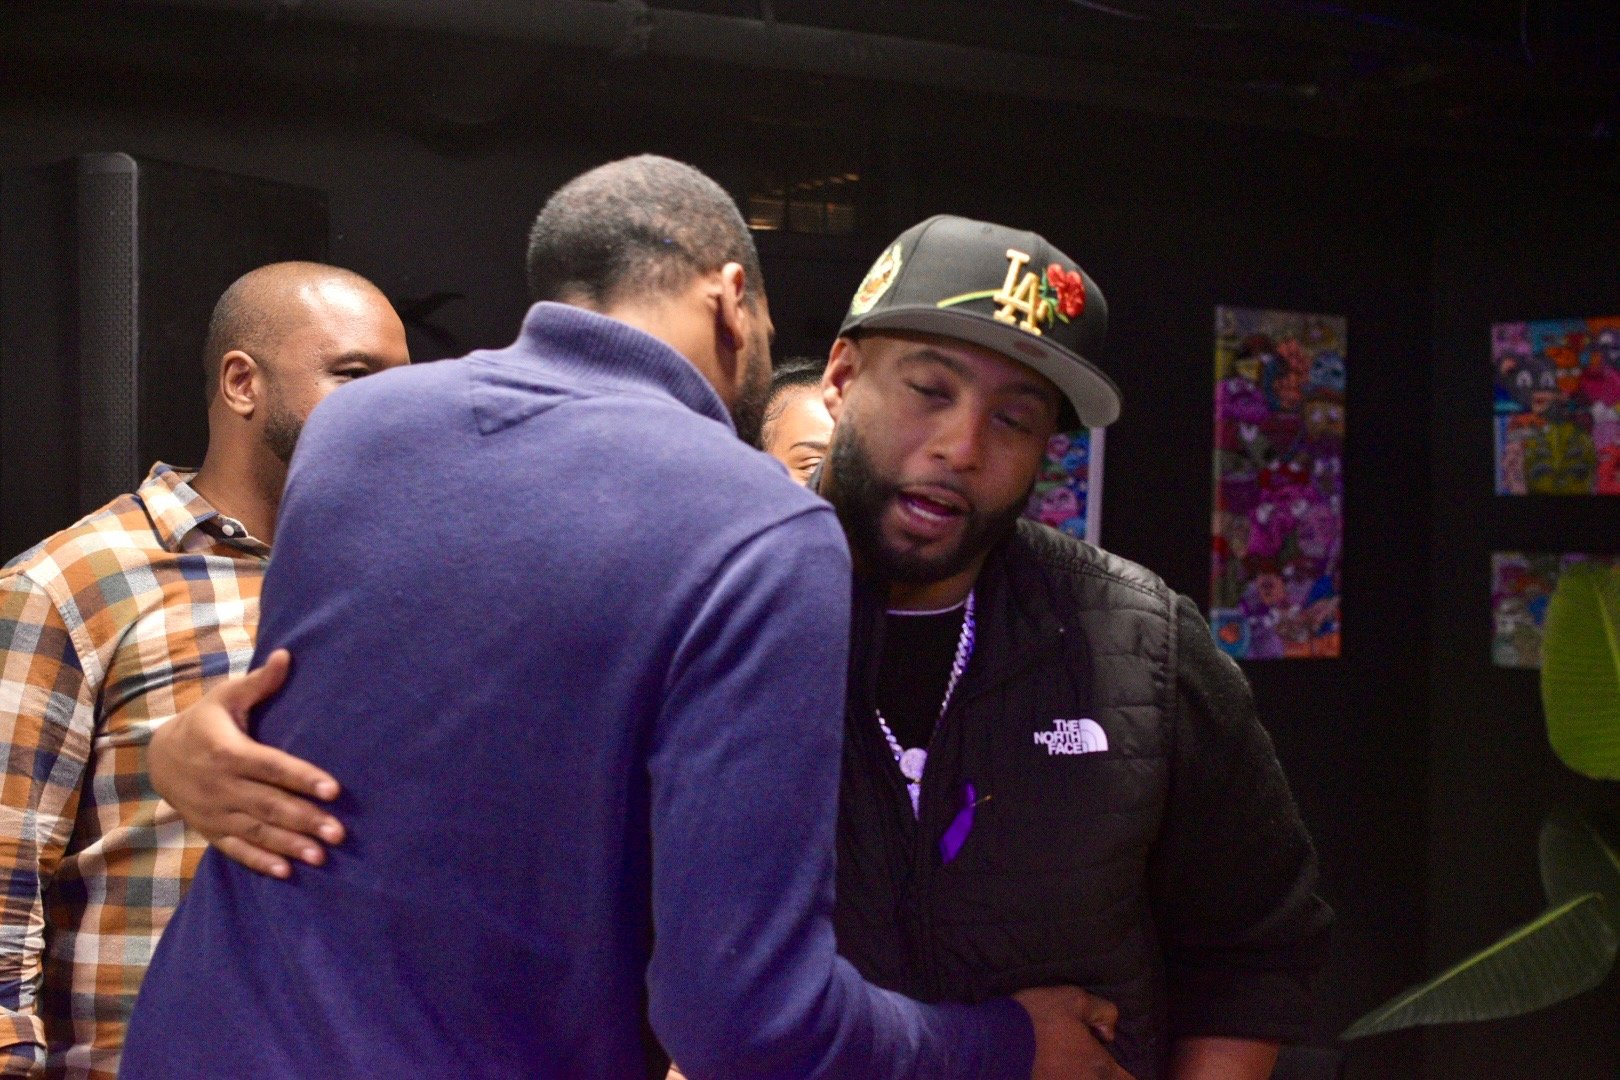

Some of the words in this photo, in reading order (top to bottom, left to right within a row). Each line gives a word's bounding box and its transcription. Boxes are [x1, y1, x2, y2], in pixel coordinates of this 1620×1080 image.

[993, 248, 1047, 336] LA
[1053, 719, 1080, 732] THE
[1033, 731, 1081, 744] NORTH
[1048, 743, 1082, 756] FACE
